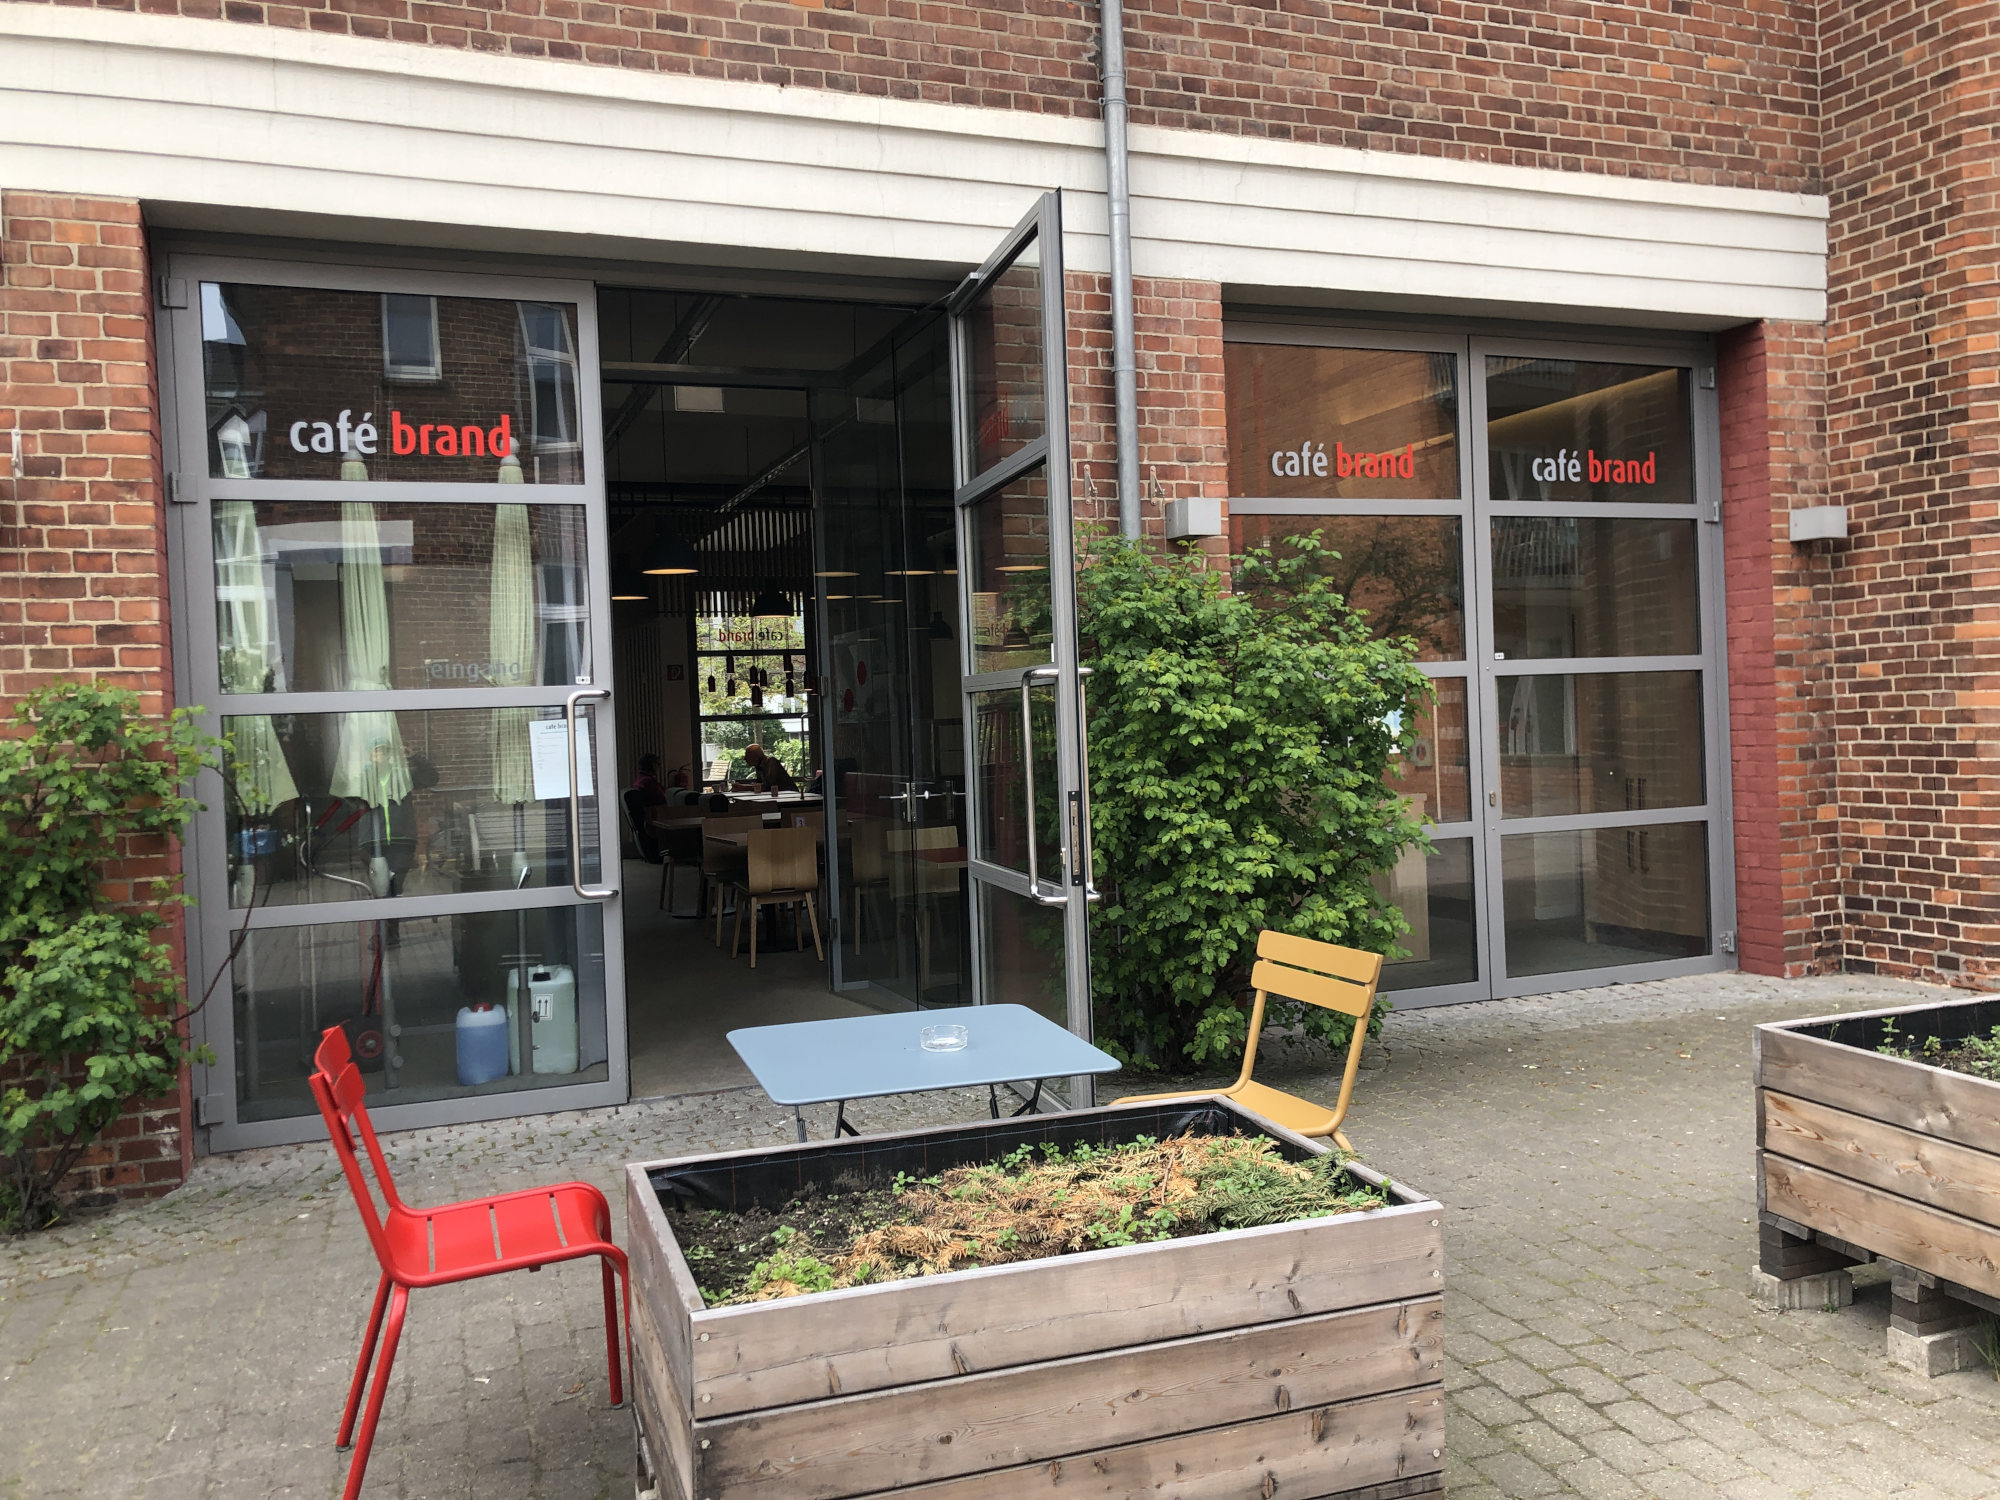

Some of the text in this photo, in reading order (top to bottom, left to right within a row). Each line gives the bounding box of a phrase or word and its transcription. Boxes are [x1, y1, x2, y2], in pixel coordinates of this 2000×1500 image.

[289, 409, 512, 457] café brand
[1271, 441, 1414, 479] café brand
[1531, 448, 1656, 484] café brand
[430, 661, 522, 683] eingang
